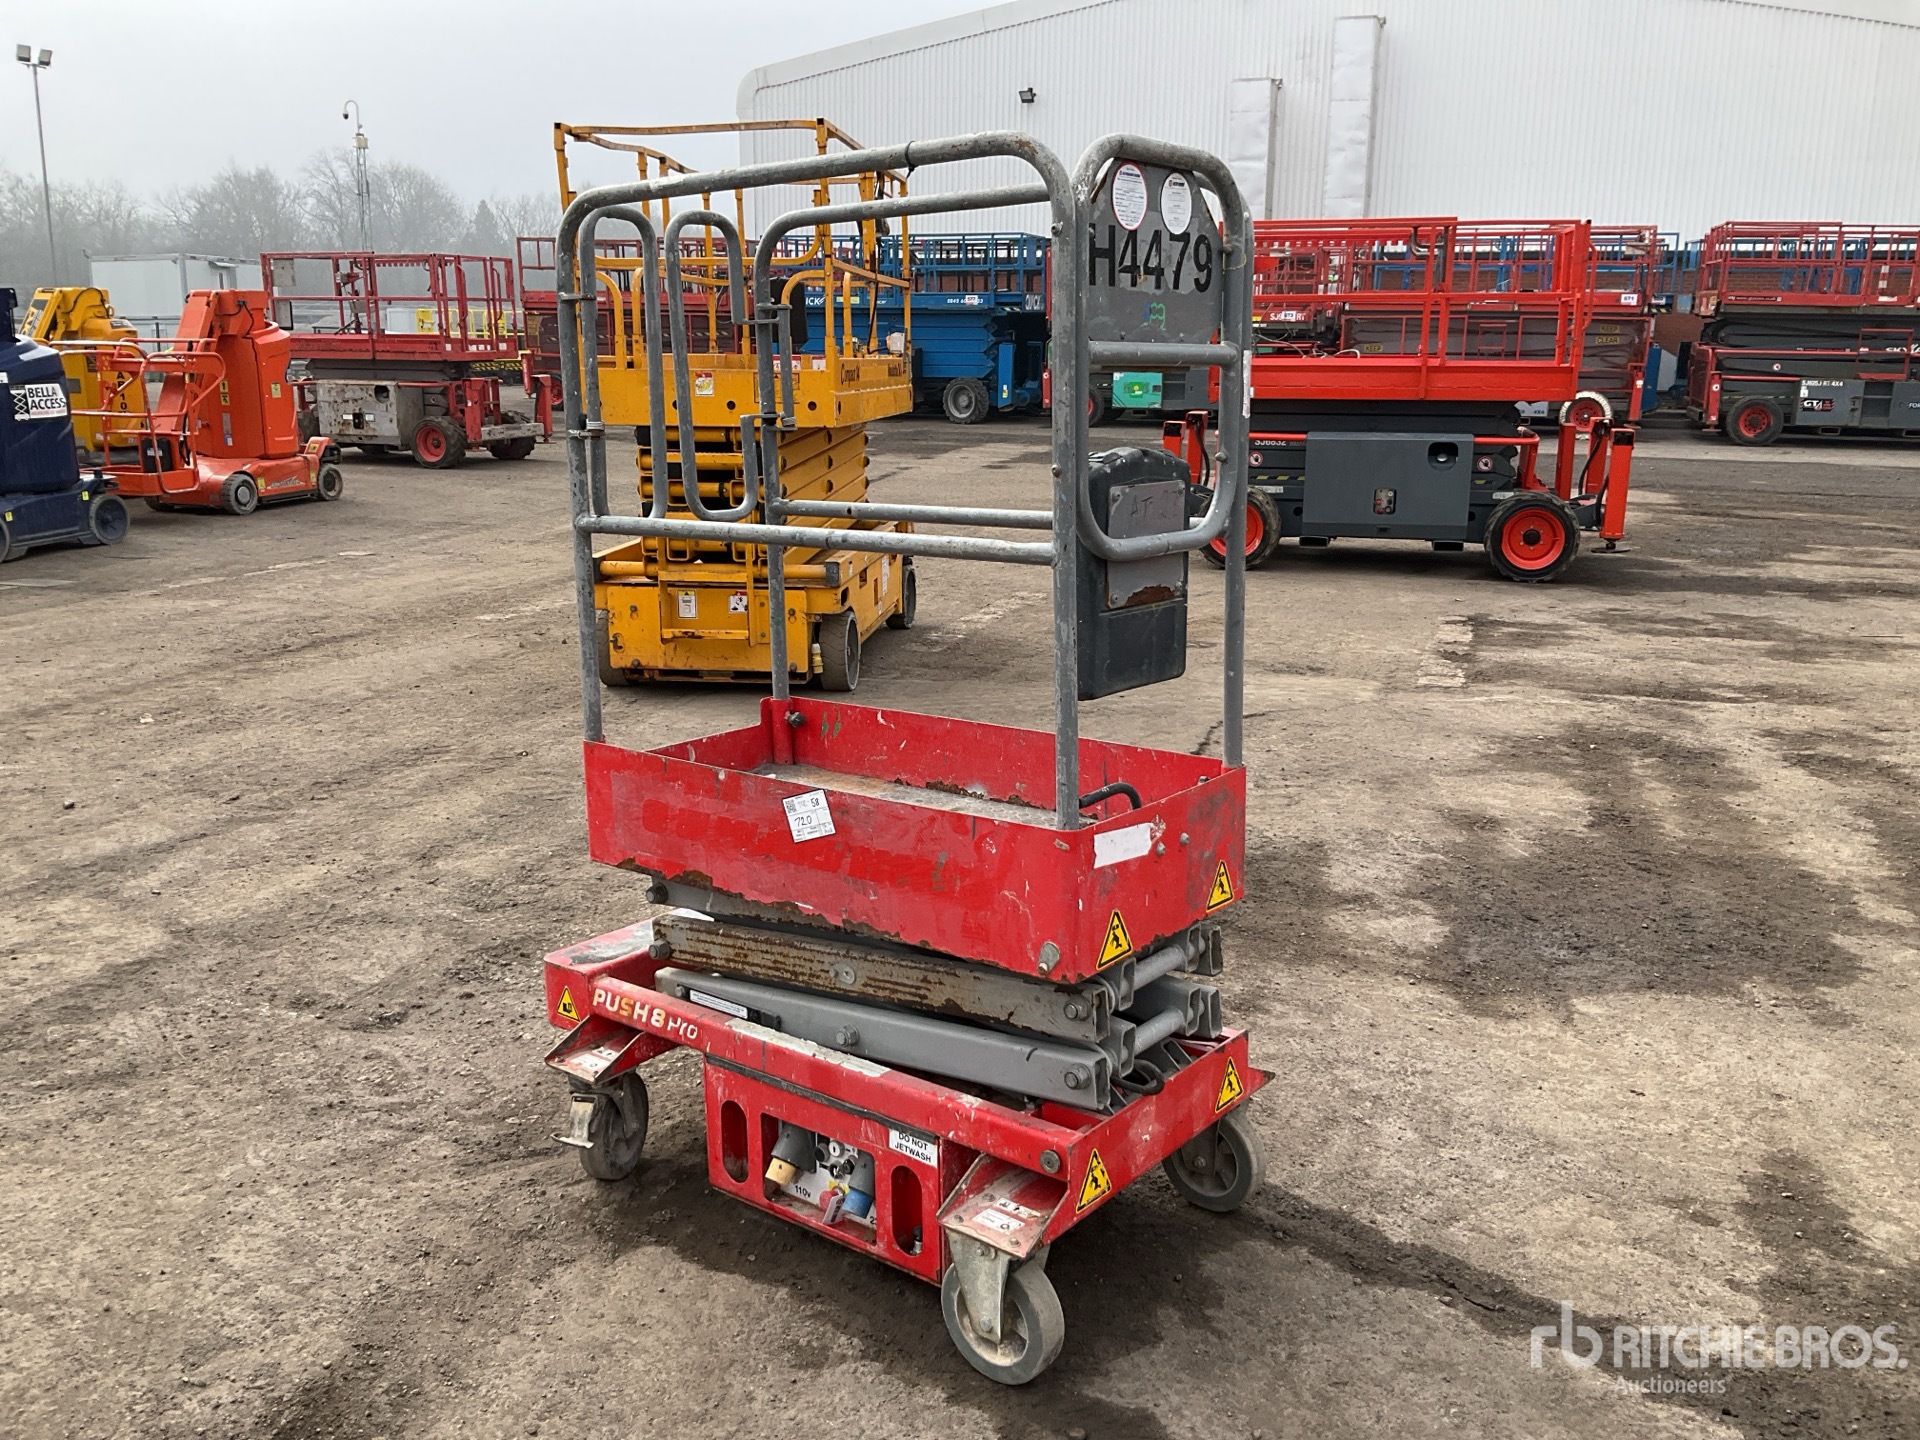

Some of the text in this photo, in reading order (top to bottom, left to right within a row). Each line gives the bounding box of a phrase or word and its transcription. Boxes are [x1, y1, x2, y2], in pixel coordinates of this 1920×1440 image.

[1088, 222, 1213, 293] H4479
[27, 387, 58, 398] BELLA
[29, 397, 66, 410] ACCESS
[810, 797, 820, 808] 58
[793, 815, 812, 827] 720
[592, 988, 649, 1023] PUSH
[650, 1008, 666, 1028] 8
[898, 1132, 929, 1151] DO NOT
[894, 1142, 932, 1163] JETWASH
